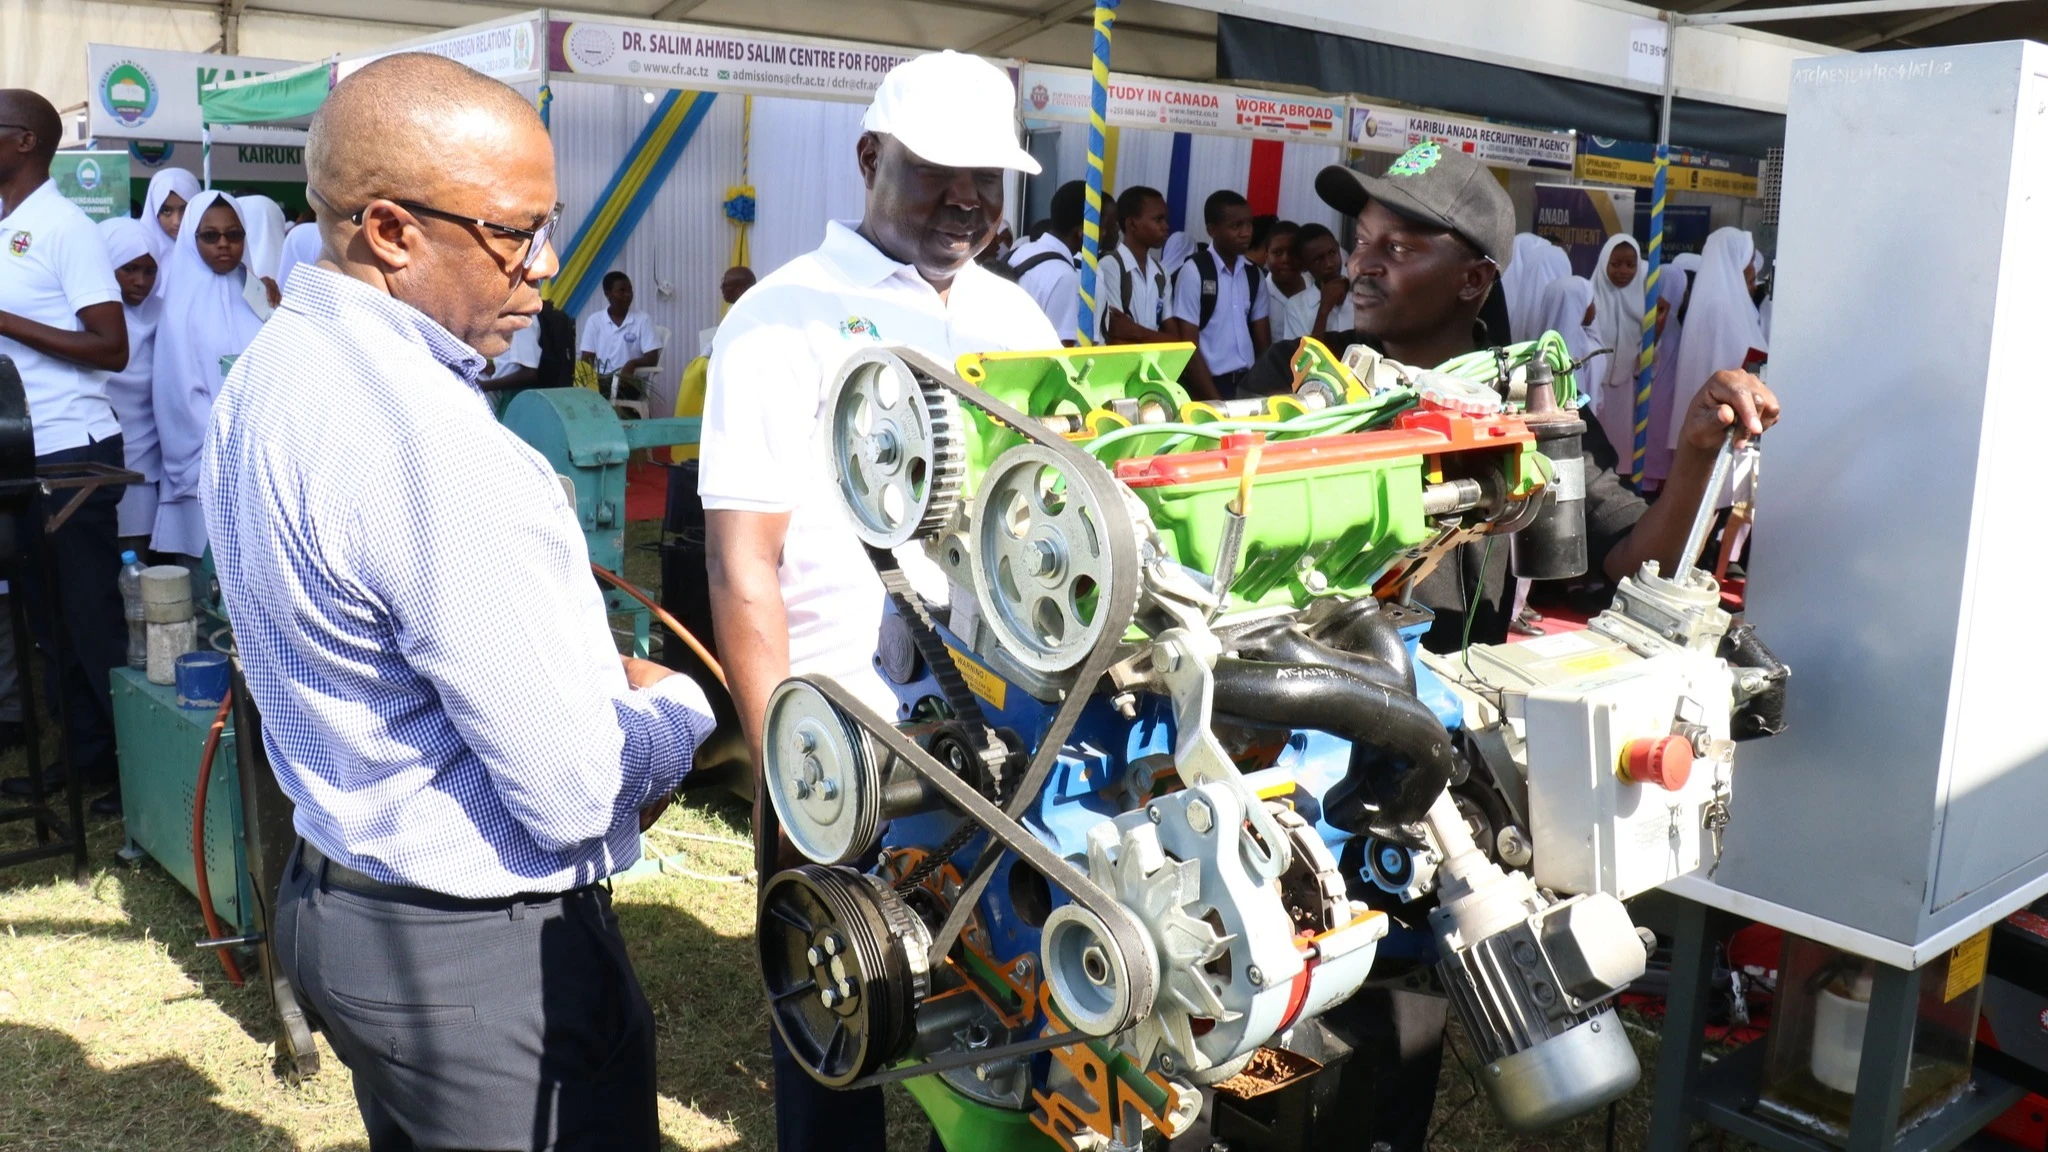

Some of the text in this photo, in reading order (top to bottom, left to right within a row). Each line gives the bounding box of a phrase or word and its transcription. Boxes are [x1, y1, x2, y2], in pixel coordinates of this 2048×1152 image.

[449, 35, 475, 59] FOREIGN
[476, 27, 511, 54] RELATIONS
[622, 31, 646, 52] DR.
[650, 33, 691, 56] SALIM
[695, 38, 744, 61] AHMED
[747, 43, 786, 64] SALIM
[789, 47, 836, 69] CENTRE
[838, 52, 862, 72] FOR
[643, 62, 709, 78] www.cfr.ac.tz
[733, 69, 825, 87] admissions@cfr.ac.tz
[1108, 85, 1219, 108] TUDY IN CANADA
[1236, 99, 1333, 120] WORK ABROAD
[1410, 118, 1444, 135] KARIBU
[1446, 124, 1478, 140] ANADA
[1480, 129, 1538, 148] RECRUITMENT
[1539, 138, 1570, 153] AGENCY
[238, 145, 301, 165] KAIRUKI
[1538, 207, 1570, 225] ANADA
[957, 656, 984, 680] WARNING
